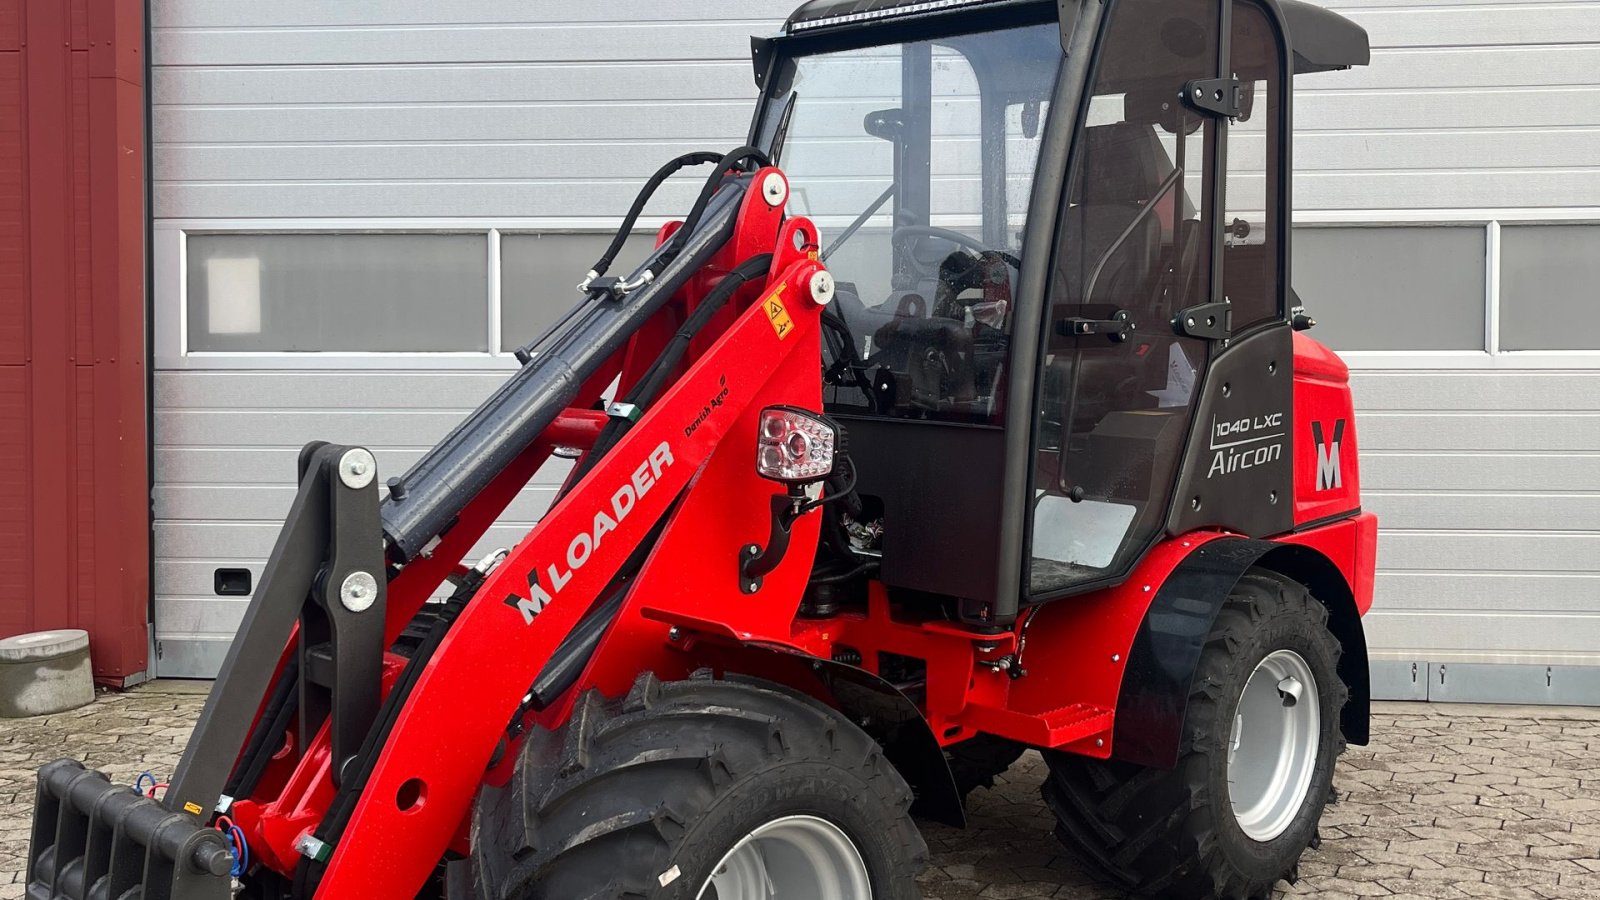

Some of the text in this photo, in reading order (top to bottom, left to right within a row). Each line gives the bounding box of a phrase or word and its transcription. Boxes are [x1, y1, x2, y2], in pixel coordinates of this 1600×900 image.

[684, 387, 729, 438] Danish Agro
[1216, 413, 1282, 437] 1040 LXC
[1207, 443, 1282, 479] Aircon
[547, 440, 675, 592] LOADER
